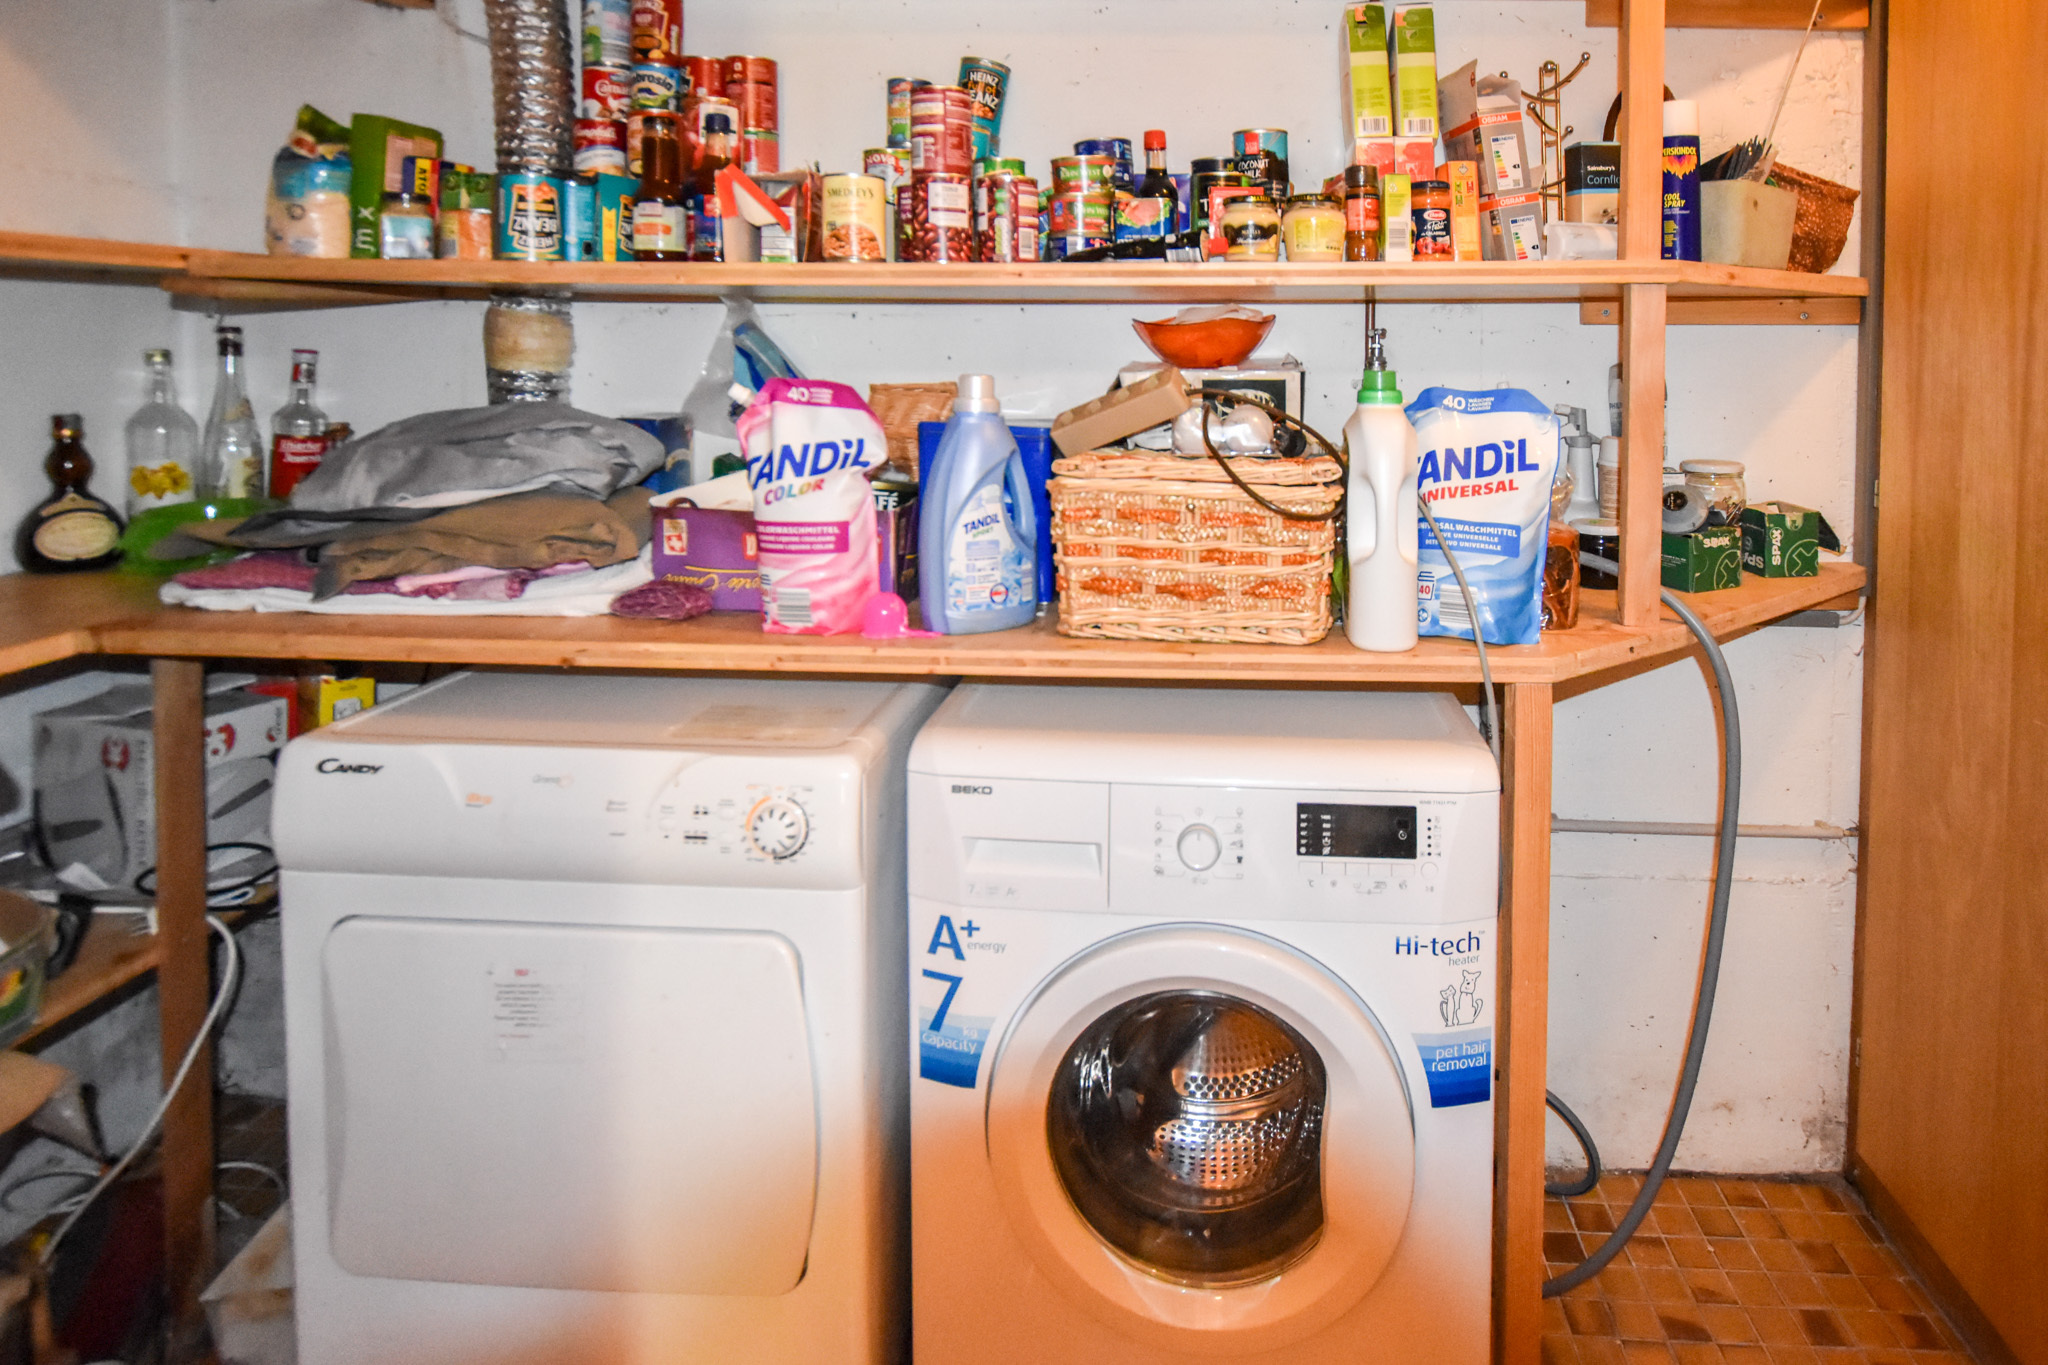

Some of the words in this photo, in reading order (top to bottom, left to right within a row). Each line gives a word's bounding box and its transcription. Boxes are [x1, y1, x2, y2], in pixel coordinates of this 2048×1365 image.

[970, 90, 999, 109] EANZ
[1482, 115, 1508, 124] OSRAM
[418, 167, 428, 193] ATO
[826, 187, 874, 198] SMEDEY'S
[1500, 195, 1526, 206] OSRAM
[1664, 200, 1686, 208] SPRAY
[787, 386, 810, 402] 40
[1442, 395, 1466, 410] 40
[1418, 438, 1540, 491] ANDiL
[764, 478, 825, 506] COLOR
[1453, 533, 1499, 543] UNIVERSELLE
[1455, 524, 1518, 537] WASCHMITTEL
[1459, 541, 1501, 551] UNIVERSALE
[1771, 529, 1781, 566] SPAX
[1419, 584, 1431, 595] 40
[316, 758, 384, 775] CANDY
[952, 785, 993, 795] BEKO
[967, 941, 1007, 953] energy
[1395, 931, 1481, 957] Hi-tech
[1448, 954, 1480, 966] heater
[922, 968, 963, 1032] 7
[922, 1031, 977, 1054] capacity
[1436, 1044, 1459, 1062] pet
[1462, 1040, 1486, 1054] hair
[1432, 1052, 1487, 1072] removal
